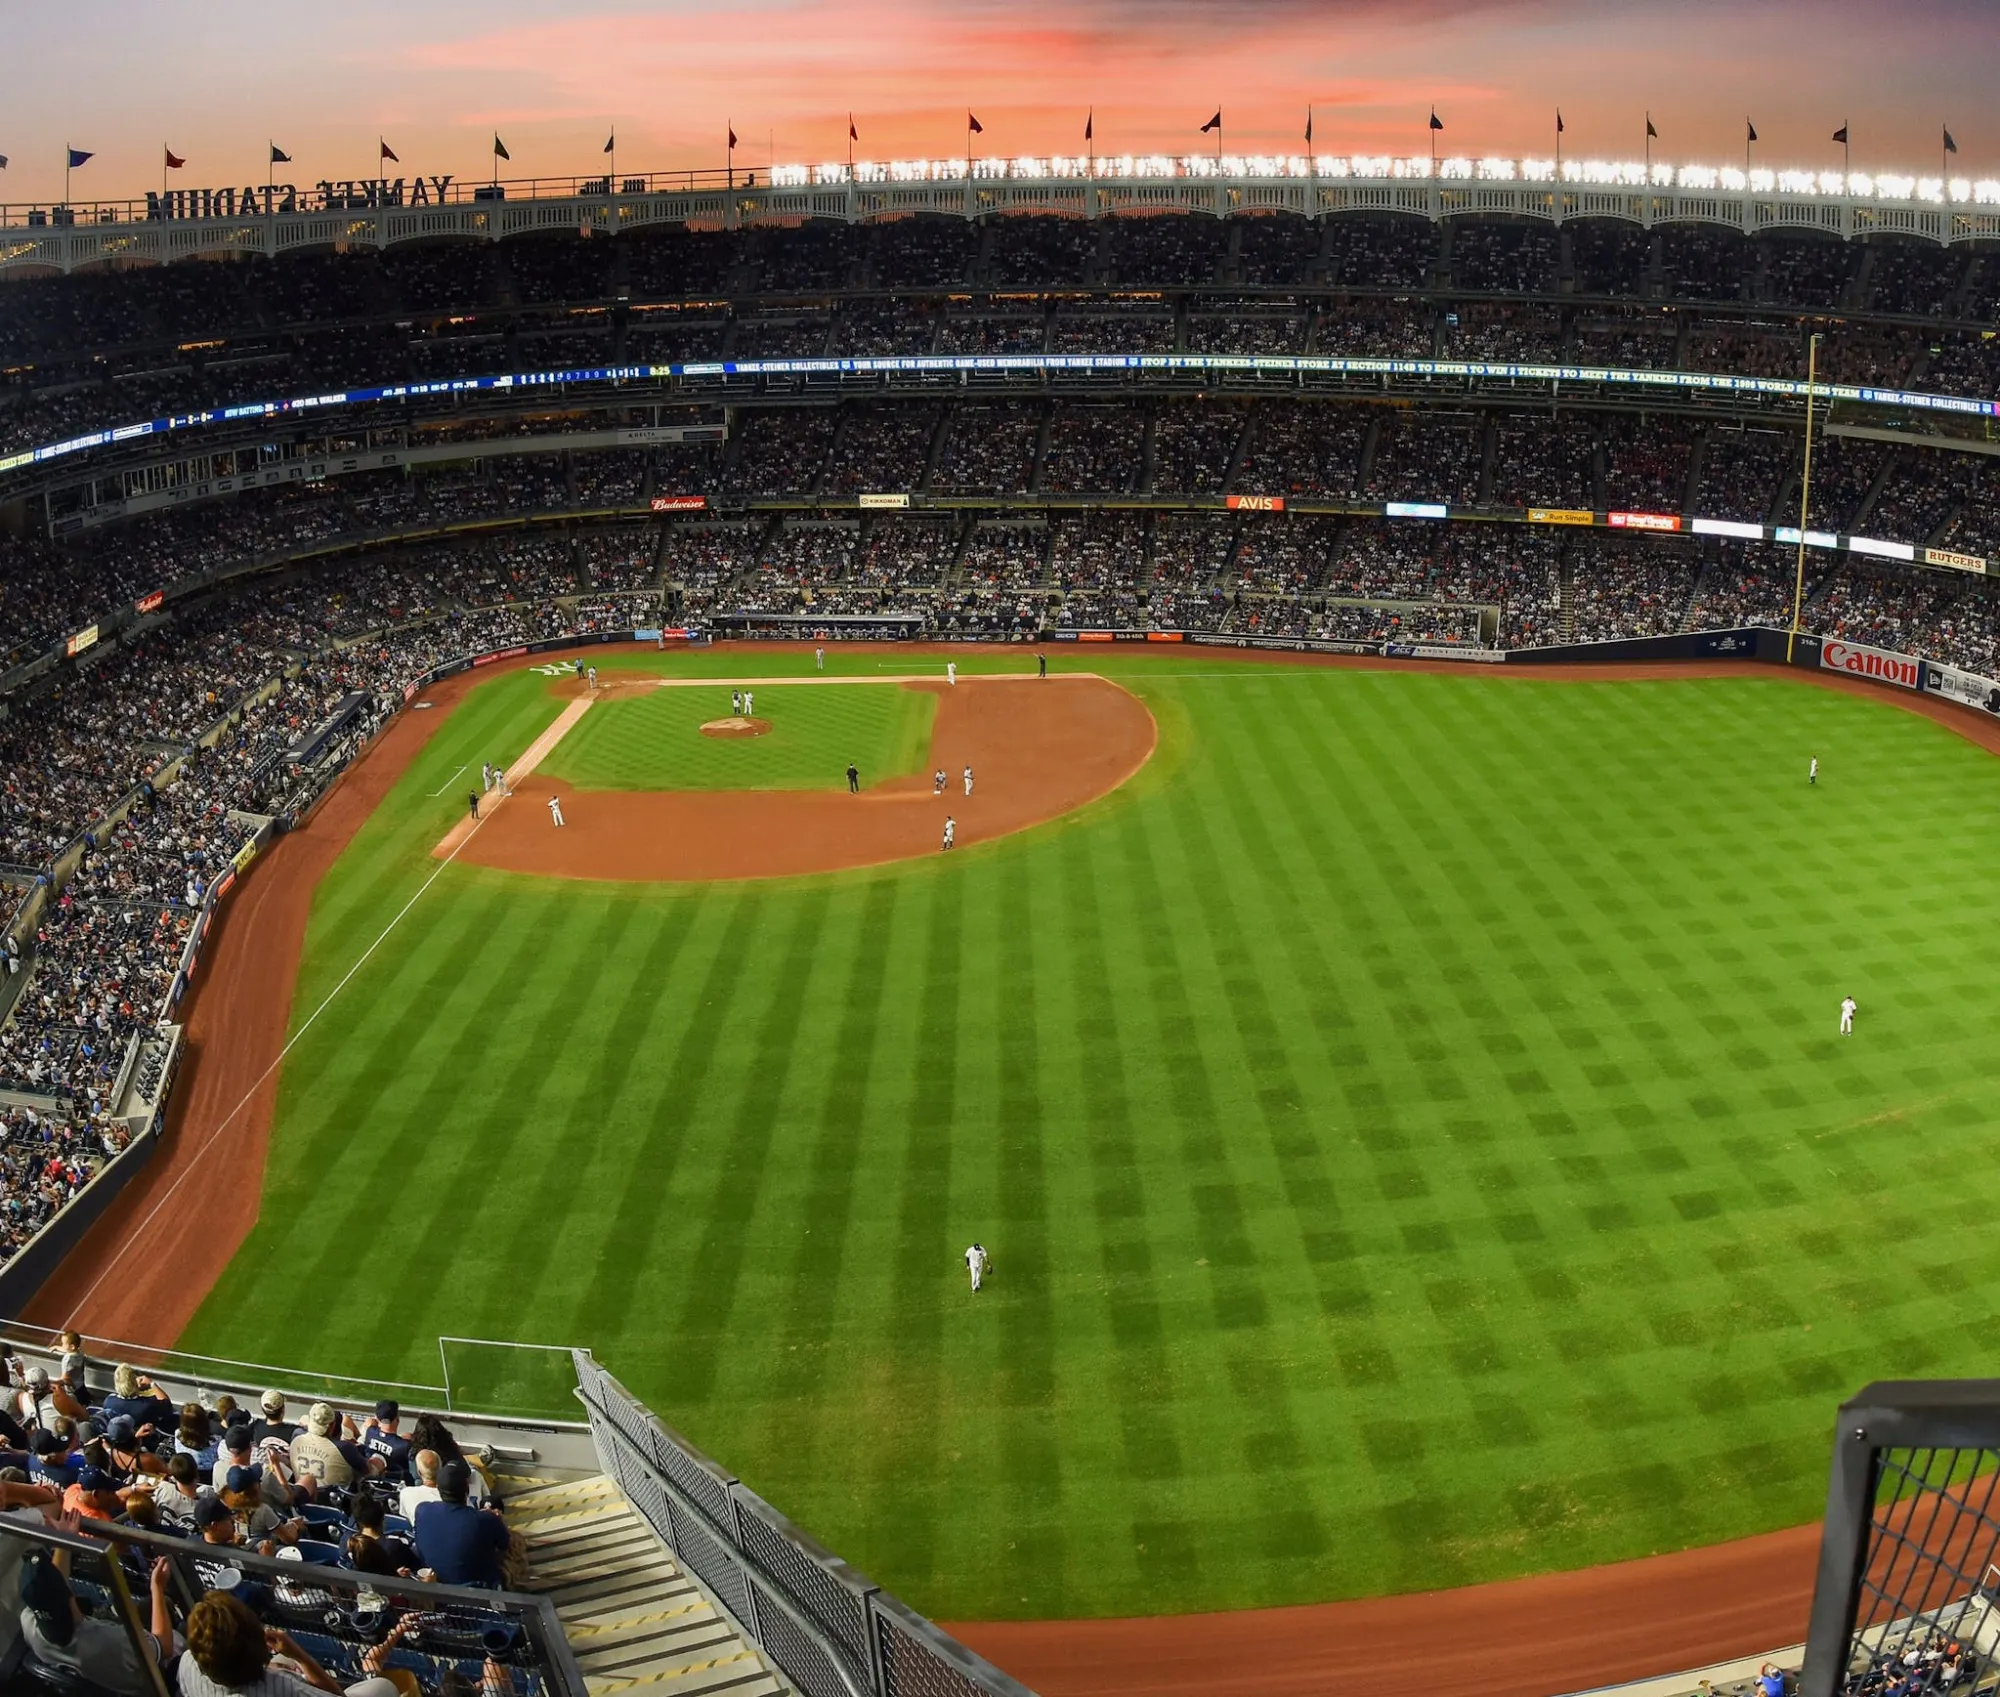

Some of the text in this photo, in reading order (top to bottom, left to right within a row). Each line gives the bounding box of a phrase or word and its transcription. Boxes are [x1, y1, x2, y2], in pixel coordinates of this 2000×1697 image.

[853, 360, 872, 370] YOUR
[873, 360, 900, 369] SOURCE
[902, 359, 915, 368] FOR
[916, 359, 954, 368] AUTHENTIC
[955, 359, 996, 368] GAME-USED
[997, 358, 1044, 368] MEMORABILIA
[1046, 358, 1066, 367] FROM
[1068, 358, 1093, 366] YANKEE
[1095, 358, 1126, 366] STADIUM
[1141, 358, 1167, 366] STOP
[1169, 358, 1182, 366] BY
[1184, 358, 1204, 367] THE
[1297, 359, 1330, 369] STORE
[1331, 360, 1344, 370] AT
[1347, 361, 1390, 371] SECTION
[1418, 363, 1433, 372] TO
[1434, 363, 1468, 374] ENTER
[1470, 365, 1485, 374] TO
[1486, 365, 1508, 375] WIN
[1517, 367, 1562, 378] TICKETS
[1563, 369, 1578, 378] TO
[1579, 369, 1608, 380] MEET
[1610, 371, 1631, 382] THE
[1632, 372, 1678, 384] YANKEES
[1680, 374, 1710, 386] FROM
[1712, 377, 1732, 388] THE
[1758, 381, 1795, 394] WORLD
[1796, 384, 1830, 395] SEIES
[1832, 386, 1860, 398] TEAM
[651, 498, 704, 510] Budweiser
[1237, 497, 1274, 510] AVIS
[1565, 514, 1589, 522] Simple
[1929, 550, 1982, 569] RUTGERS
[1252, 640, 1295, 648] WEATHERPROOF
[1823, 642, 1916, 685] Canon
[369, 1438, 392, 1456] JETER
[298, 1456, 325, 1480] 23
